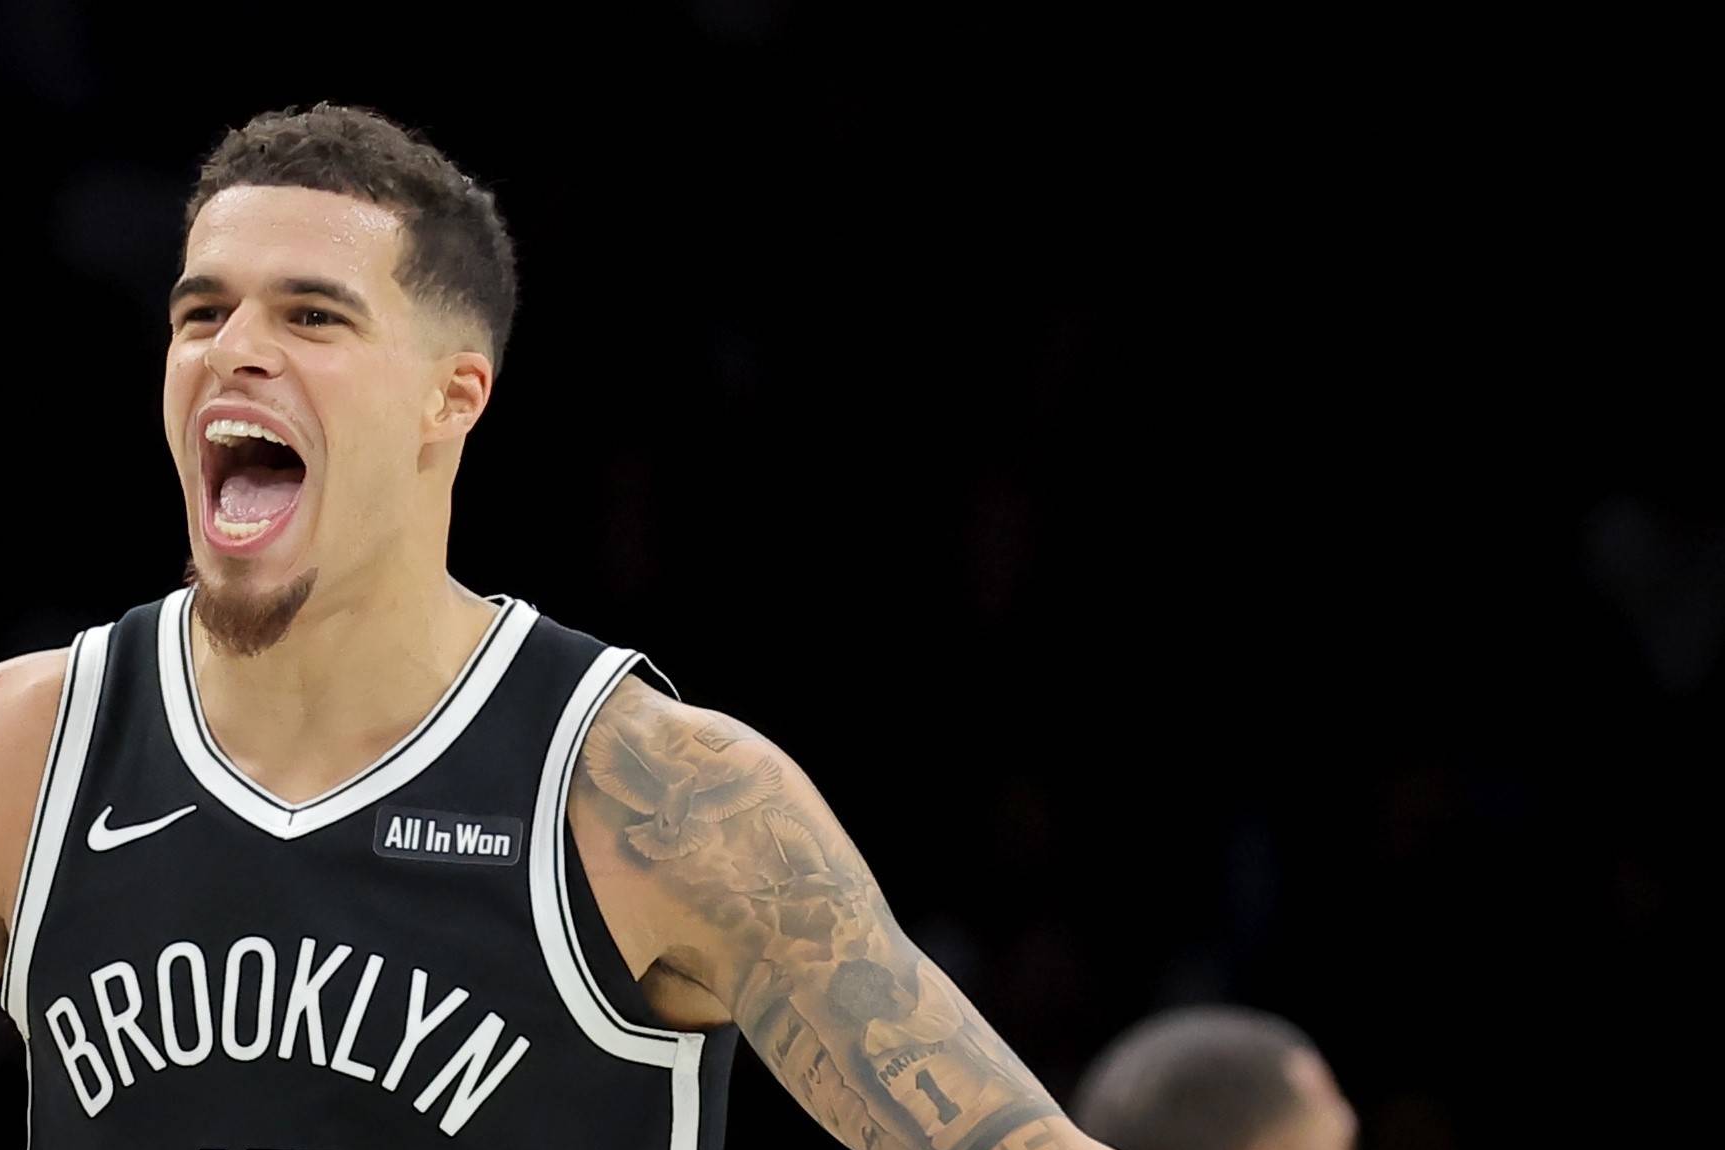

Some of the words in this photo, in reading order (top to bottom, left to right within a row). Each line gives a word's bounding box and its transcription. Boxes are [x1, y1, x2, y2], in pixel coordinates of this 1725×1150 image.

[384, 815, 423, 851] All
[425, 820, 451, 853] In
[456, 823, 511, 857] Won
[43, 934, 531, 1138] BROOKLYN
[915, 1068, 963, 1125] 1
